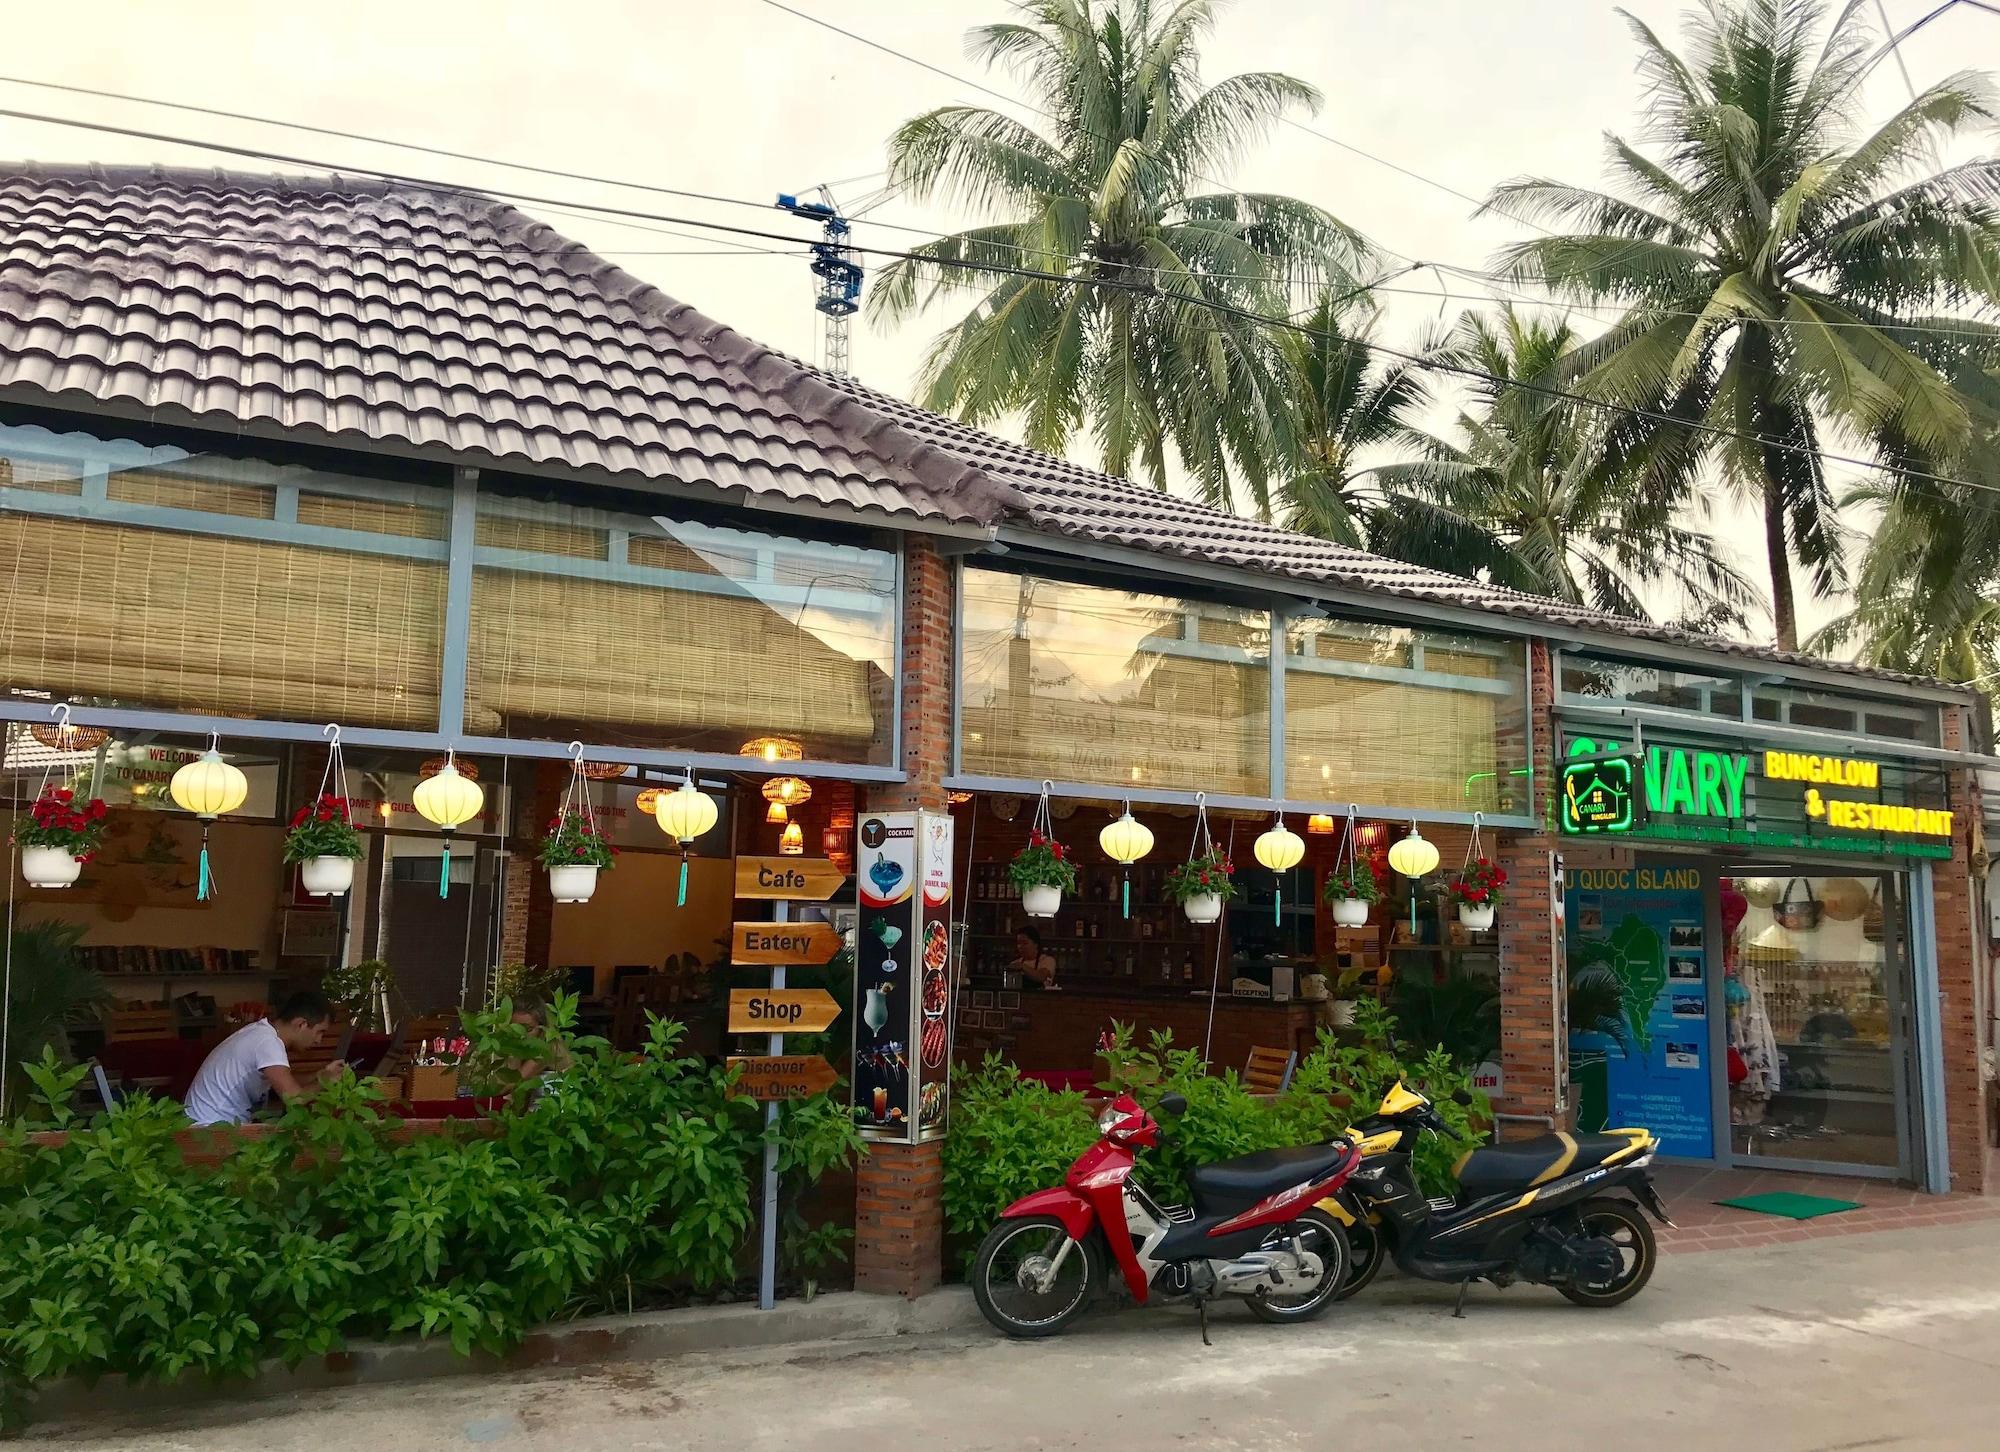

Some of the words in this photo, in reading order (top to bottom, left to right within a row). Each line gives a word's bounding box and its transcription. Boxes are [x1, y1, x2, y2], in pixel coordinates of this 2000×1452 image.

[149, 748, 200, 762] WELCOME
[115, 767, 130, 780] TO
[1569, 738, 1748, 818] NARY
[1764, 751, 1879, 788] BUNGALOW
[349, 798, 371, 808] OME
[391, 802, 416, 812] GUES
[1579, 802, 1607, 814] CANARY
[1805, 789, 1825, 817] &
[1828, 800, 1954, 836] RESTAURANT
[759, 867, 805, 888] Cafe
[1580, 869, 1629, 891] QUOC
[1636, 869, 1700, 890] ISLAND
[745, 931, 812, 955] Eatery
[748, 998, 802, 1023] Shop
